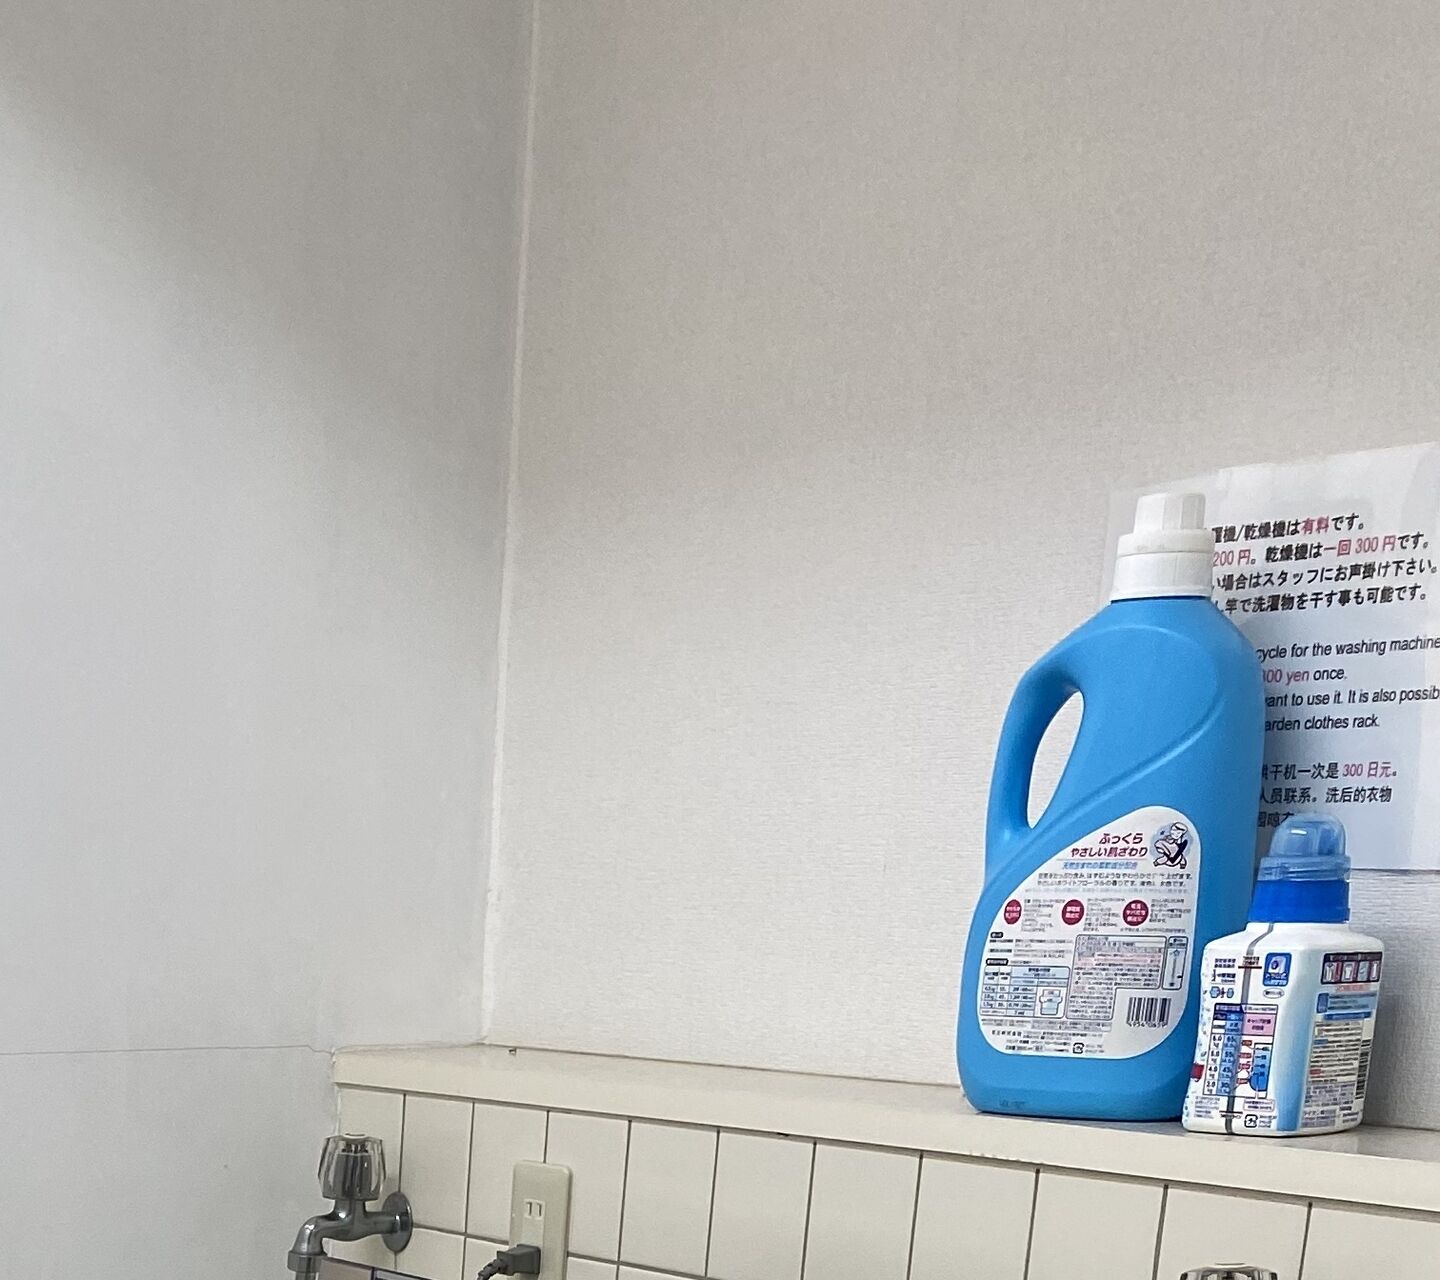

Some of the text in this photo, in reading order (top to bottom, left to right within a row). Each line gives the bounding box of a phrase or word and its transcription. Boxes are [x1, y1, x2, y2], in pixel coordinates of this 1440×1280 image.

[1355, 536, 1379, 553] 300
[1291, 643, 1309, 658] for
[1312, 643, 1332, 656] the
[1335, 639, 1387, 655] washing
[1389, 635, 1440, 651] machine
[1286, 670, 1310, 685] yen
[1313, 667, 1348, 681] once.
[1265, 693, 1288, 707] ant
[1291, 693, 1302, 706] to
[1307, 693, 1330, 706] use
[1359, 689, 1368, 703] is
[1372, 688, 1397, 702] also
[1304, 715, 1349, 729] clothes
[1343, 763, 1363, 777] 300
